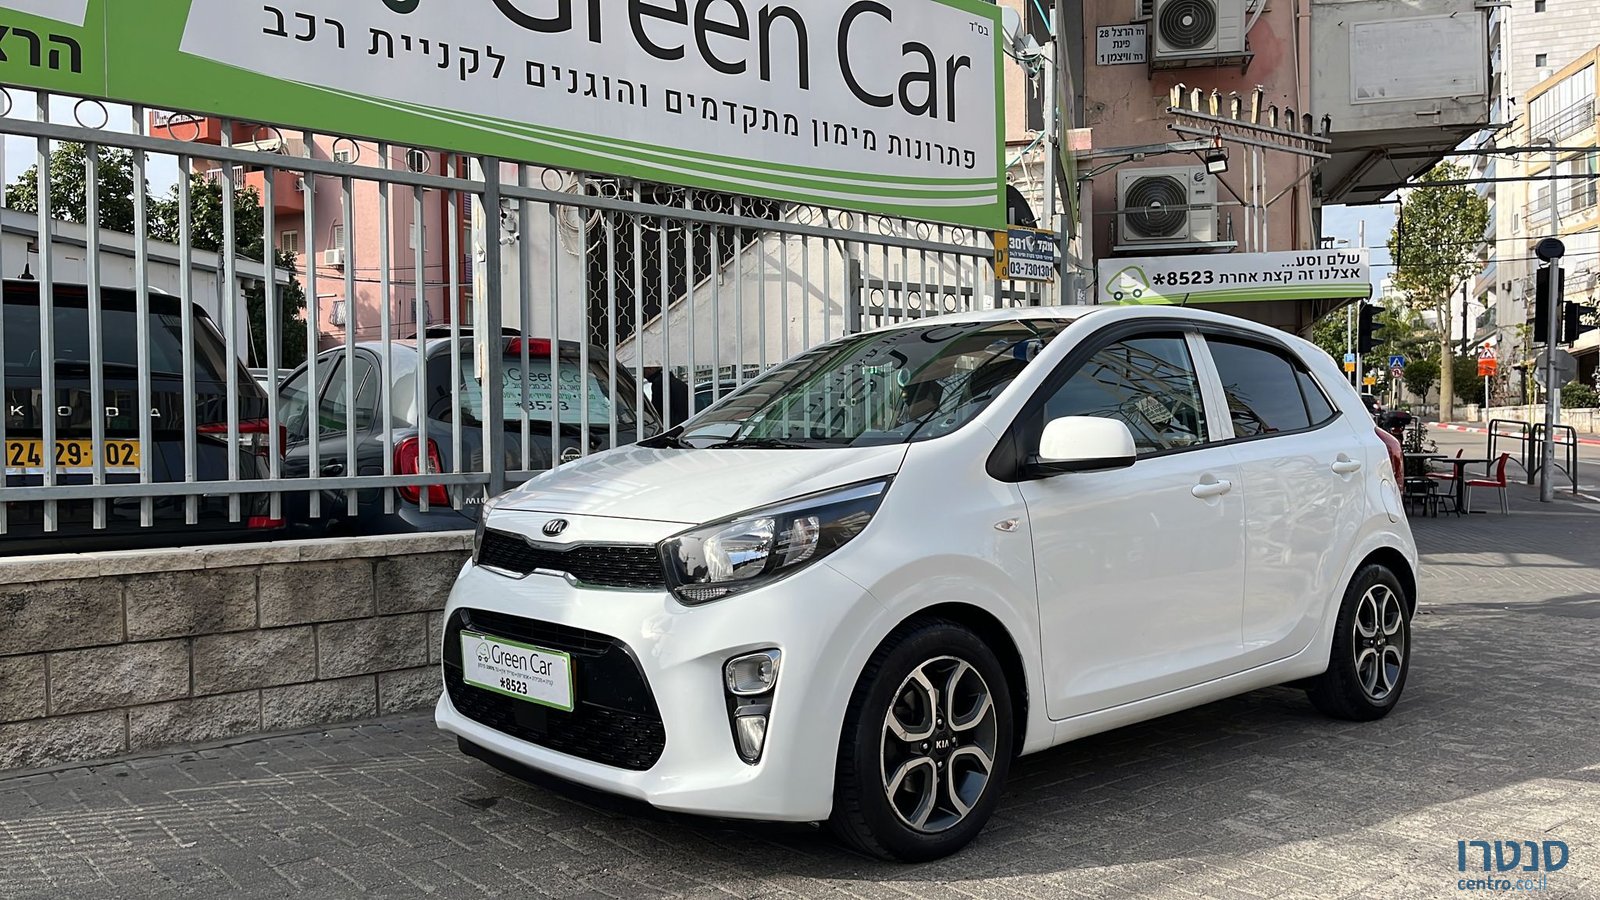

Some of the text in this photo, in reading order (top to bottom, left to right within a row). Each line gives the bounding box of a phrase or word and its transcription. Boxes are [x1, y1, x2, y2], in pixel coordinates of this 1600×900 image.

[1099, 30, 1110, 38] 28
[1111, 27, 1134, 37] הרצל
[1112, 40, 1131, 49] פינת
[490, 0, 972, 123] een Car
[1100, 54, 1105, 62] 1
[262, 5, 976, 170] פתרונות מימון מתקדמים והוגנים לקניית רכב
[1009, 237, 1026, 250] 301
[1326, 253, 1361, 266] שלם
[1010, 261, 1054, 278] 03-7301301
[1298, 270, 1315, 281] זה
[1318, 267, 1361, 281] אצלנו
[1218, 272, 1259, 284] אחרת
[1262, 269, 1293, 286] קצת
[543, 520, 565, 532] KIA
[491, 644, 528, 671] Green
[529, 653, 553, 676] Car
[935, 740, 949, 749] KIA
